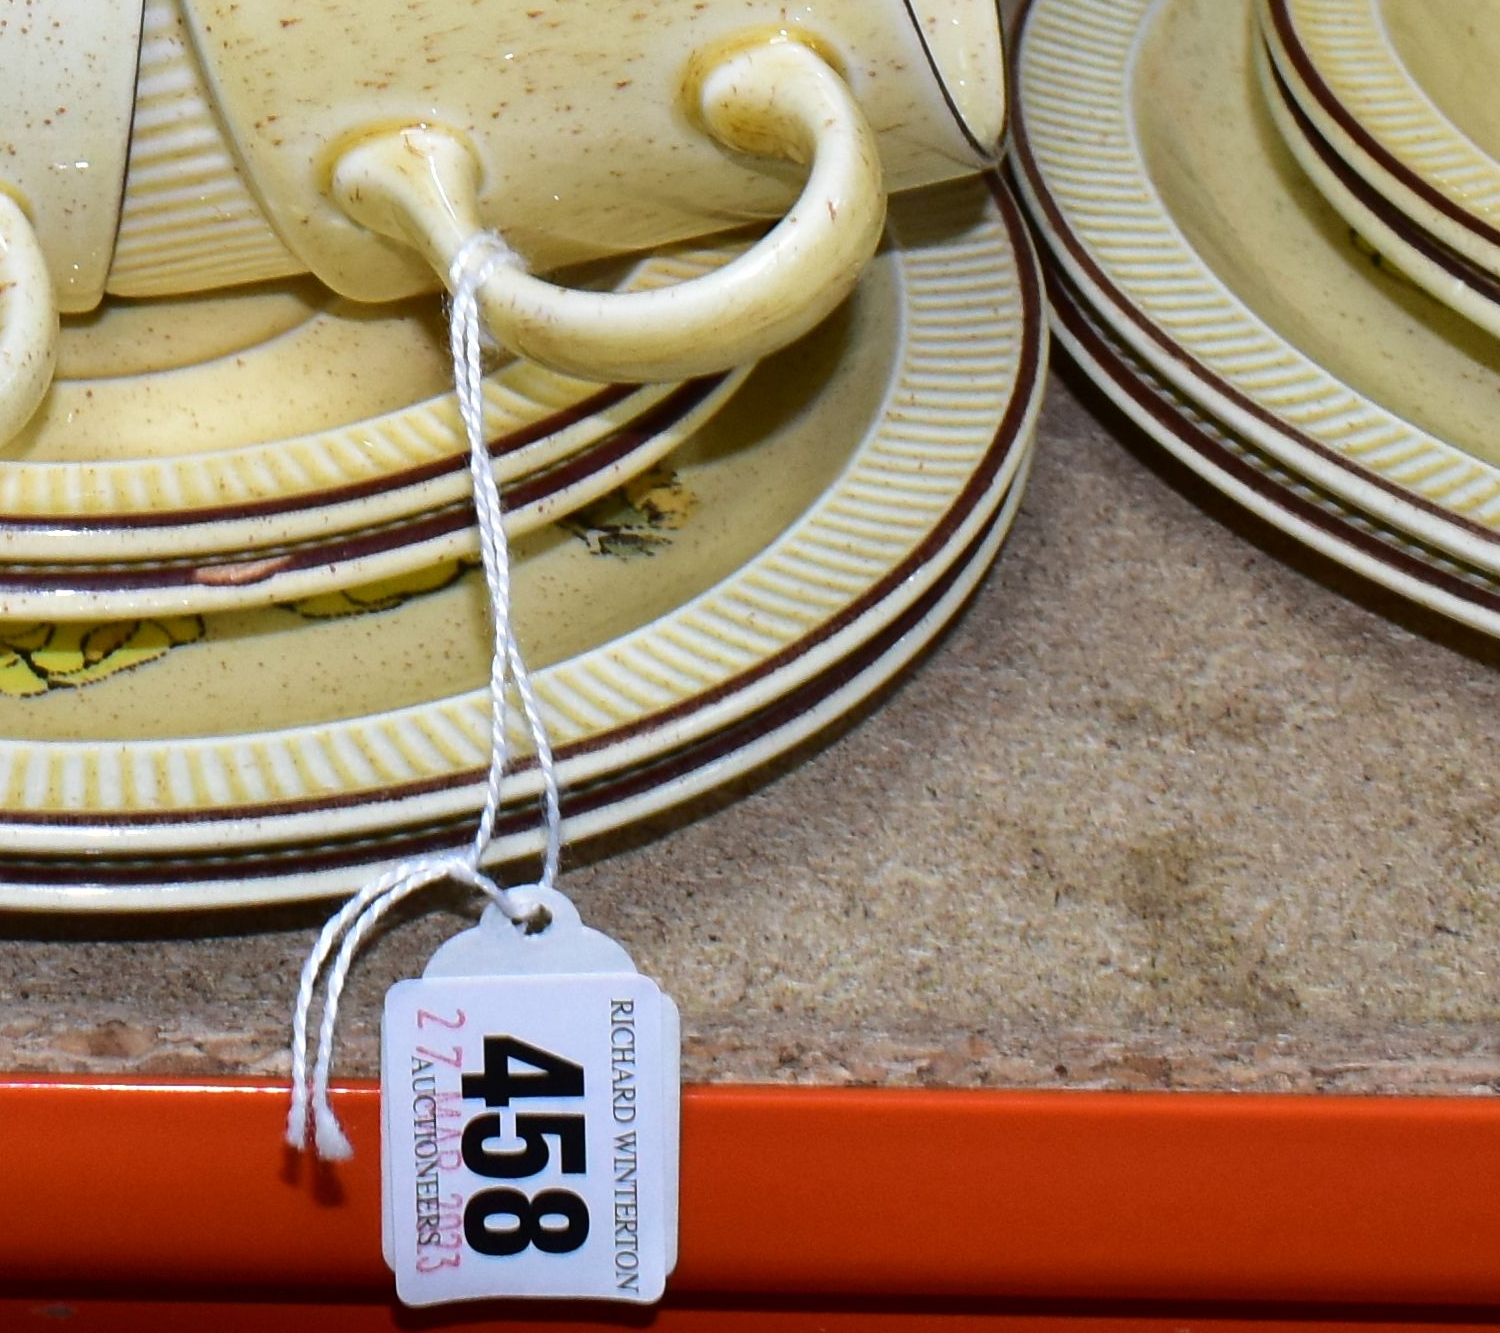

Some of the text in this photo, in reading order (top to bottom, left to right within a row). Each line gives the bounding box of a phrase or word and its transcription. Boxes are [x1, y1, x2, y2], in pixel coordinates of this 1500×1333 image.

[410, 1055, 442, 1246] AUCTIONEERS
[415, 1192, 464, 1274] 2023
[460, 1034, 590, 1256] 458
[610, 997, 640, 1294] RICHARD WINTERTON
